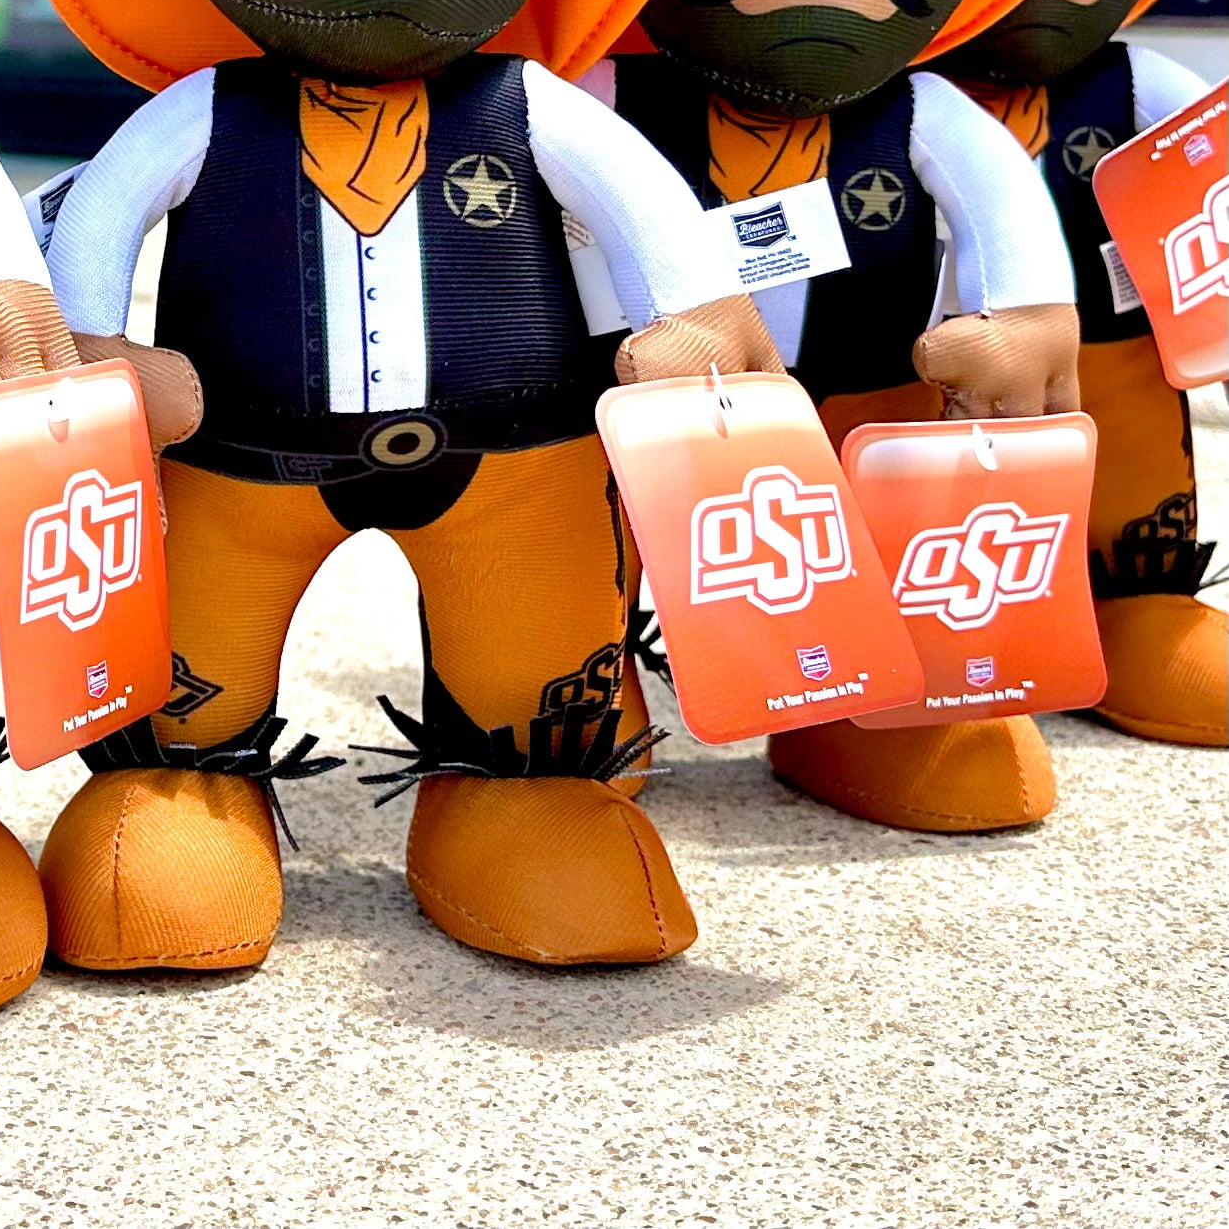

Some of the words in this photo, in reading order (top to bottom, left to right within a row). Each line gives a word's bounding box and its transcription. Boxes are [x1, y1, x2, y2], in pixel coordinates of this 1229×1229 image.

[24, 473, 140, 627] OSU
[693, 468, 849, 611] OSU
[896, 505, 1065, 626] OSU
